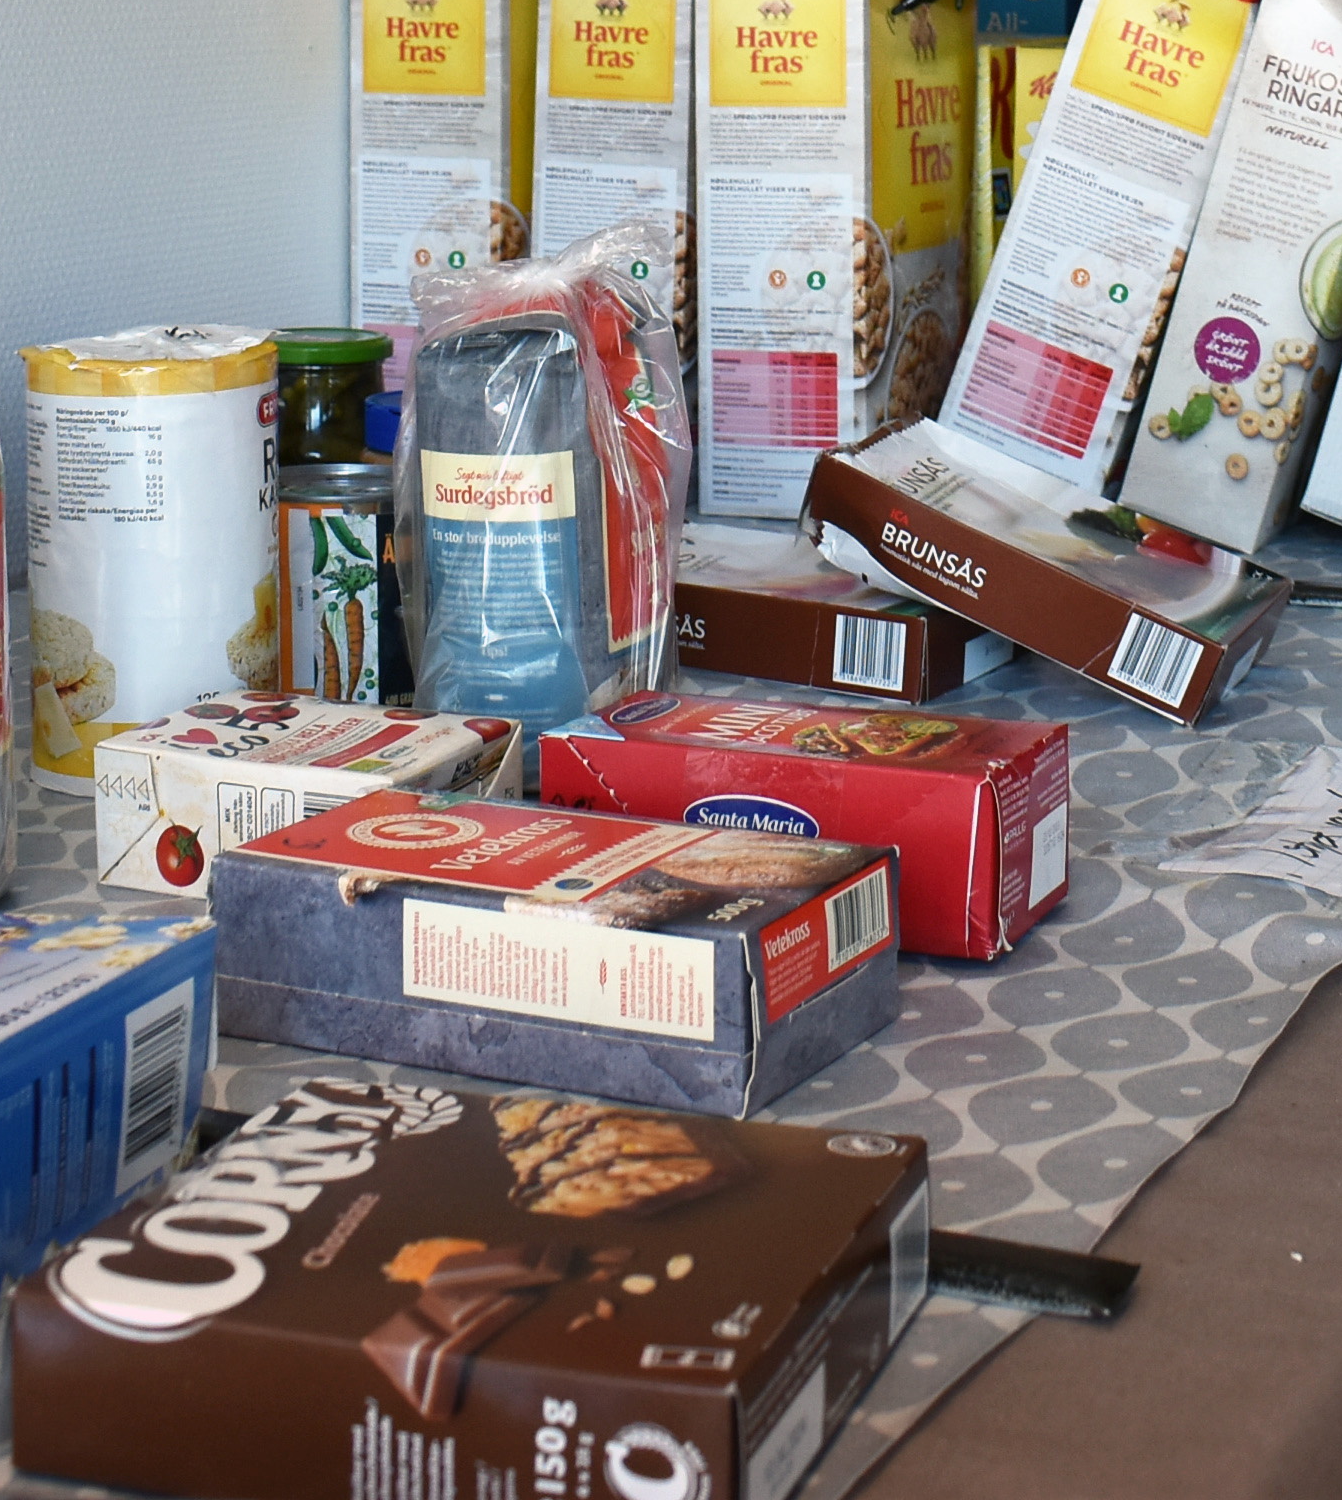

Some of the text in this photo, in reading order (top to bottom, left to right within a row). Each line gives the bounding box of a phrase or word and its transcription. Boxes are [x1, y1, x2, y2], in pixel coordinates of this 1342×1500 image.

[386, 17, 459, 40] Havre
[575, 21, 649, 44] Havre
[735, 26, 818, 49] Havre
[398, 38, 448, 63] fras
[586, 43, 635, 68] fras
[1119, 19, 1205, 69] Havre
[1311, 38, 1335, 56] ICA
[750, 48, 804, 74] fras
[1123, 47, 1181, 89] fras
[895, 79, 961, 129] Havre
[1265, 124, 1330, 150] NATURELL
[909, 132, 954, 186] fras
[893, 456, 951, 496] UNSÅS
[435, 483, 554, 510] Surdegsbröd
[889, 509, 910, 526] ICA
[432, 527, 561, 548] En stor brödupplevelse
[881, 522, 987, 587] BRUNSÅS
[687, 703, 792, 743] MINI
[697, 807, 805, 836] Santa Maria
[430, 817, 574, 873] Vetekross
[764, 921, 811, 961] Vetekross
